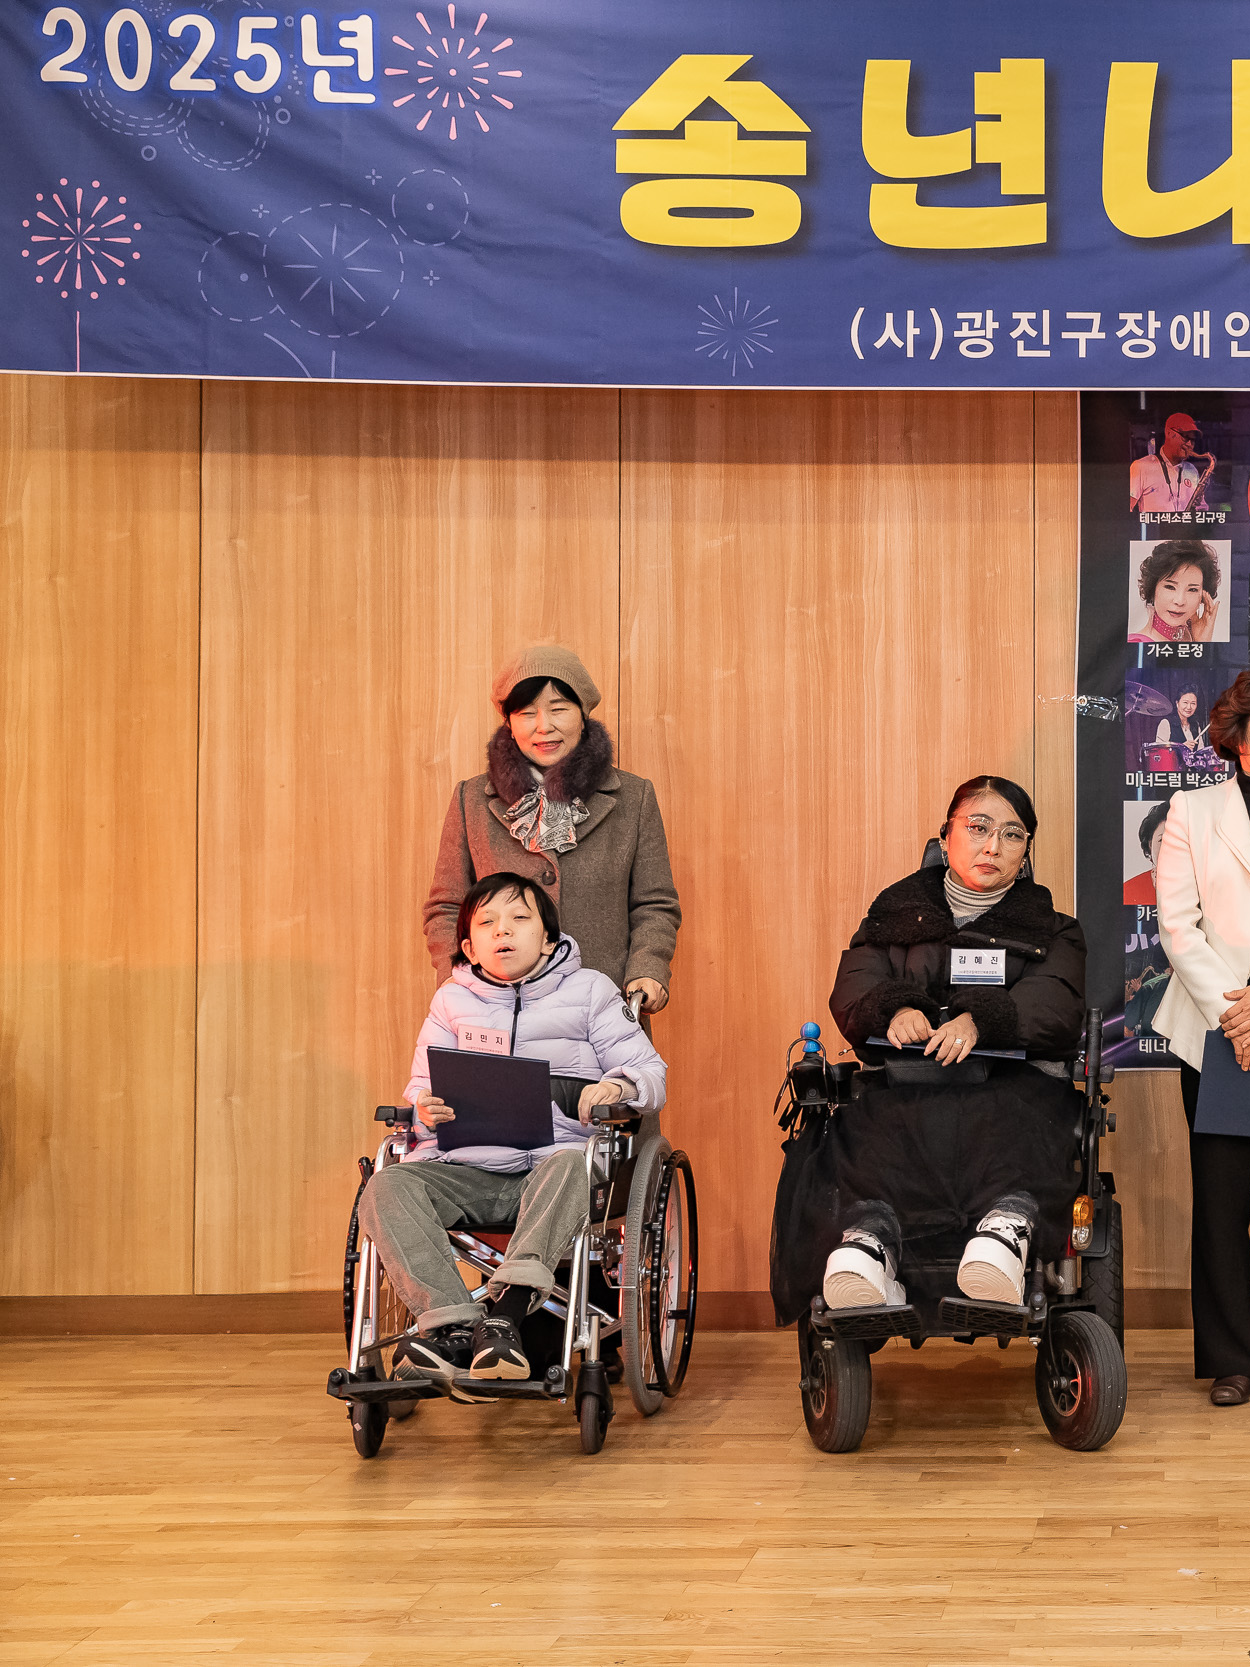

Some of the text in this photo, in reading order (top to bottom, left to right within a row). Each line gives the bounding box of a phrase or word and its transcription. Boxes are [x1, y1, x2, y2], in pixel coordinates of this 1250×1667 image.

[40, 7, 376, 105] 2025년
[1139, 512, 1226, 525] 테너색소폰 김규명
[1147, 644, 1204, 658] 가수 문정
[1125, 772, 1182, 787] 미녀드럼
